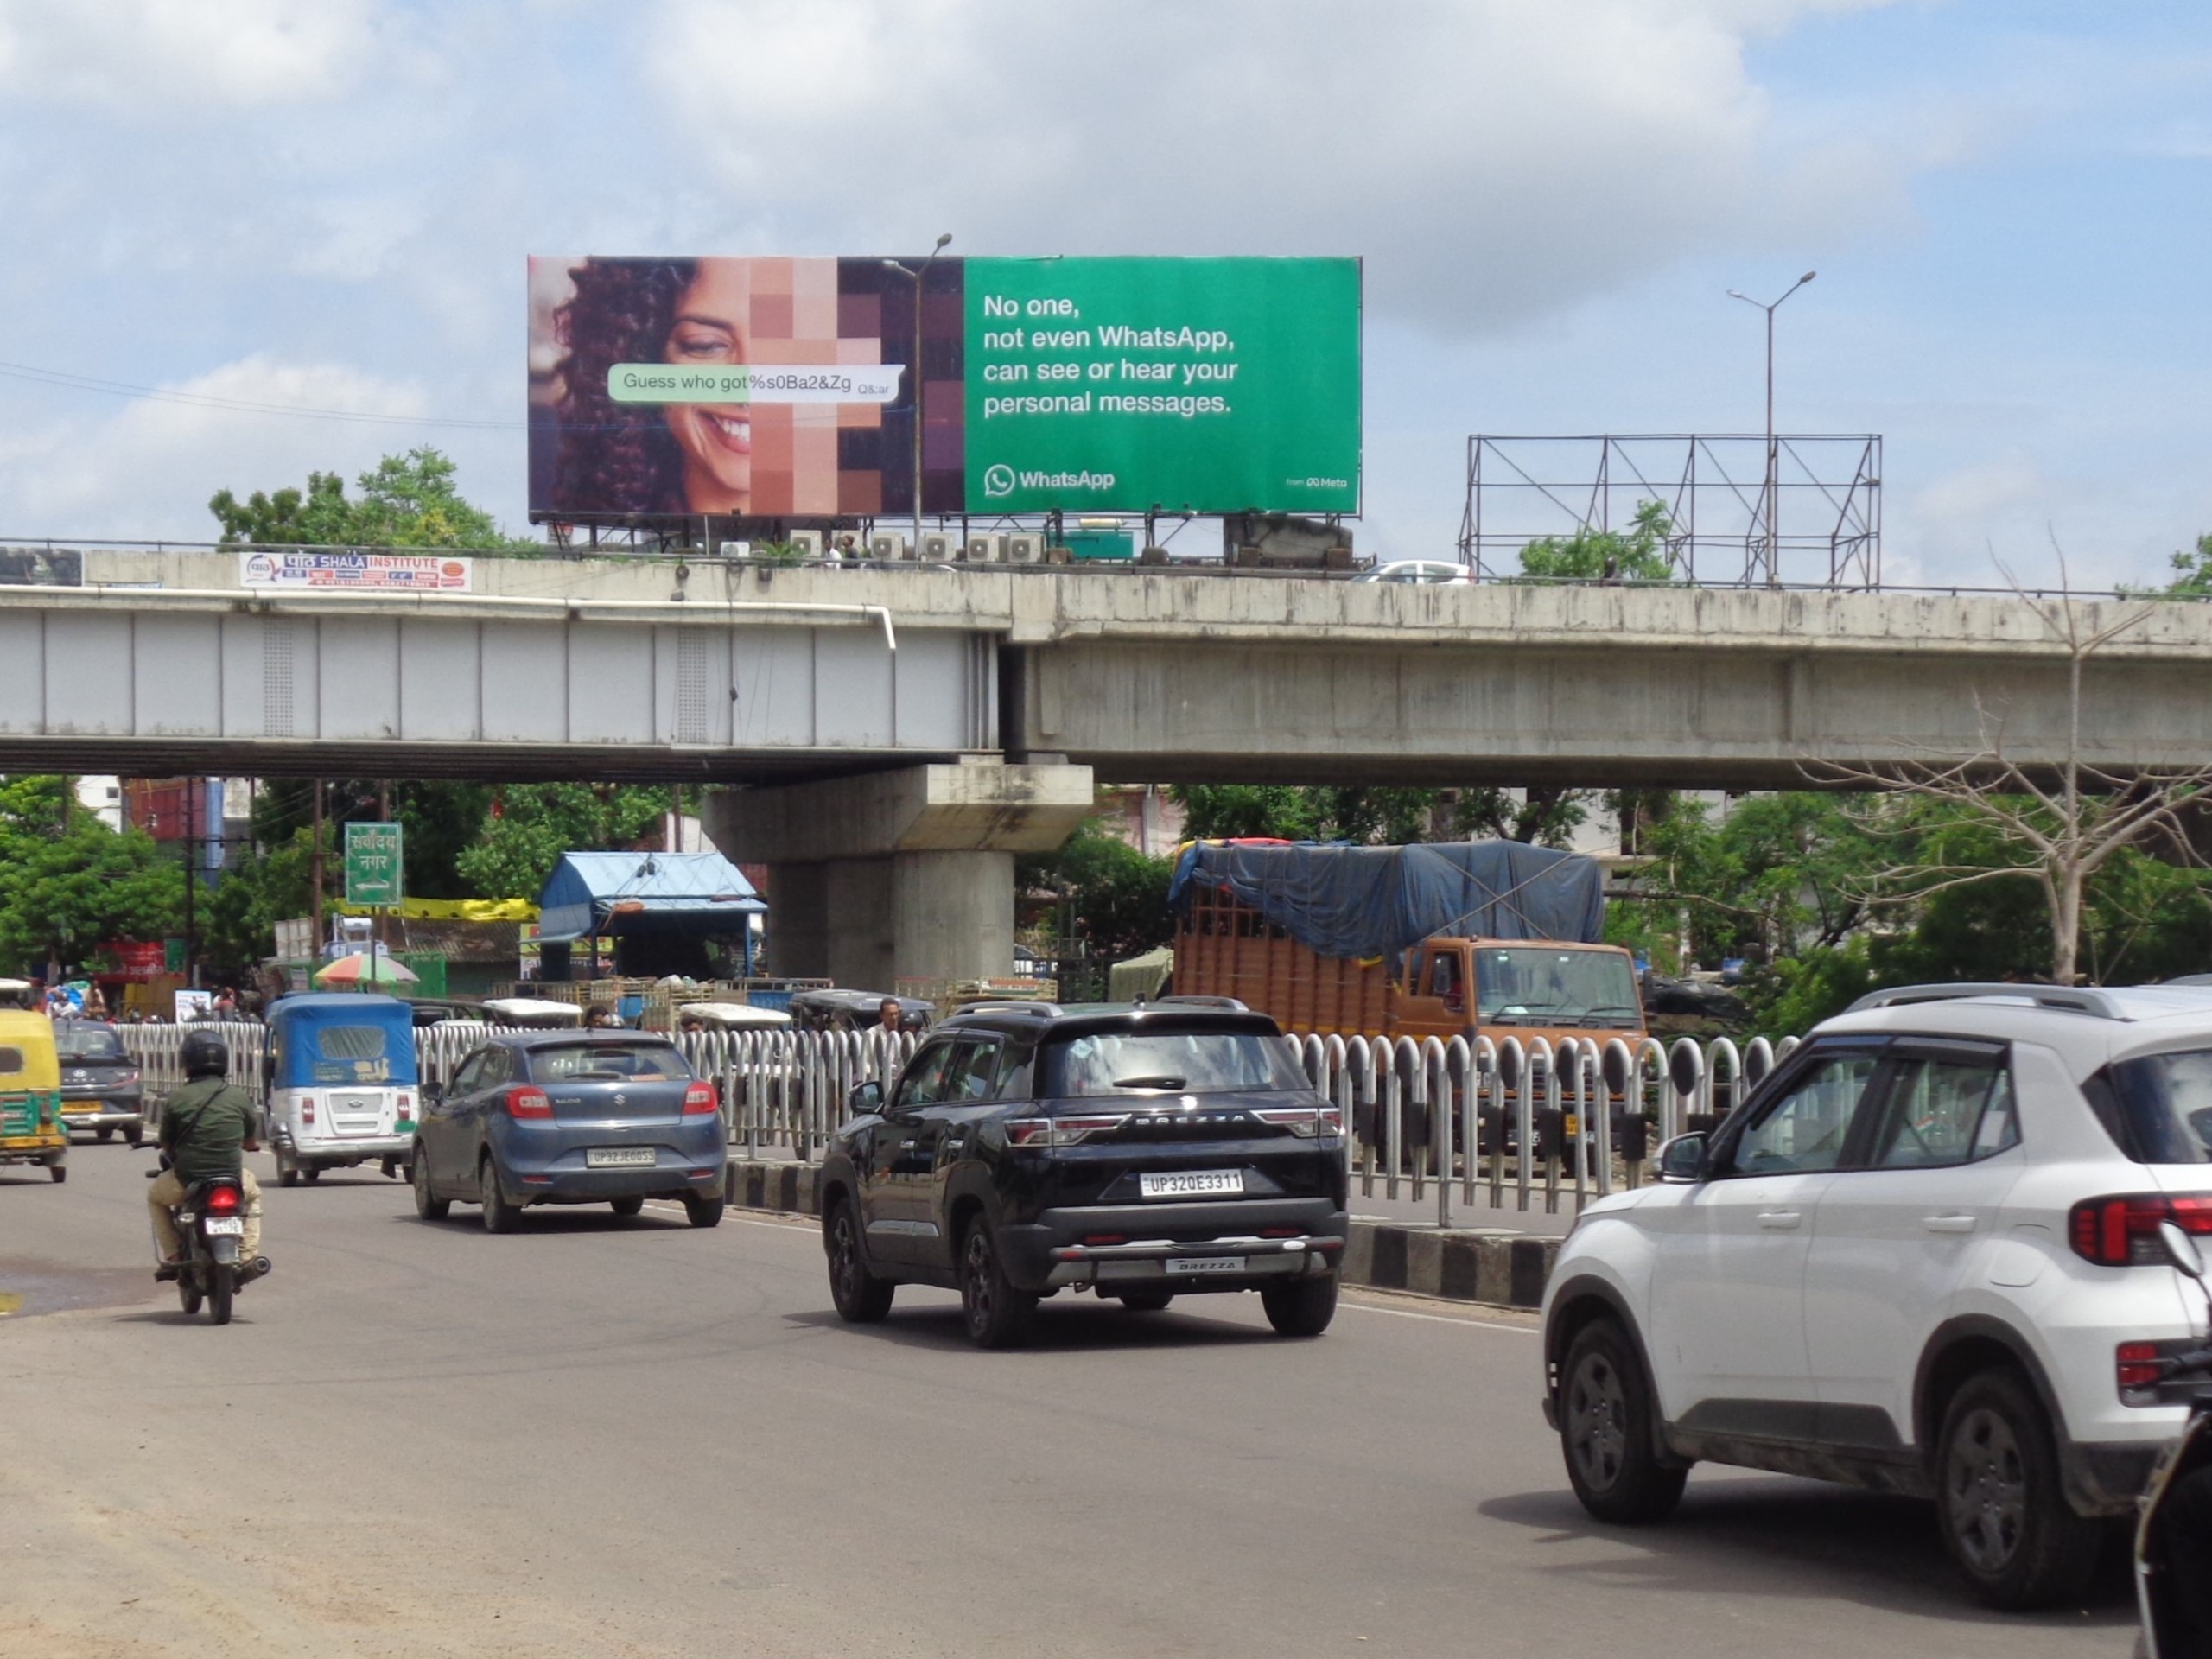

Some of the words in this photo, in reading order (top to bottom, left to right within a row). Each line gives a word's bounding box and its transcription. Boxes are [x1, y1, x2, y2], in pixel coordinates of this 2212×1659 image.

[984, 296, 1019, 316] No
[1027, 297, 1080, 319] one,
[984, 328, 1024, 348] not
[1031, 329, 1090, 347] even
[1098, 326, 1235, 353] WhatsApp,
[983, 362, 1028, 381] can
[1037, 361, 1080, 379] see
[1088, 361, 1114, 379] or
[1120, 357, 1176, 379] hear
[1183, 361, 1238, 385] your
[623, 372, 676, 388] Guess
[681, 374, 715, 389] who
[721, 375, 747, 393] got
[984, 391, 1090, 418] personal
[1098, 394, 1231, 417] messages.
[1019, 470, 1115, 490] WhatsApp
[1320, 478, 1347, 487] Meta
[286, 556, 315, 568] पाठ
[321, 556, 365, 568] SHALA
[370, 556, 439, 568] INSTITUTE
[359, 855, 387, 870] नगर
[1135, 1115, 1246, 1125] BREZZA
[1151, 1173, 1241, 1192] UP32QE3311
[1179, 1262, 1236, 1270] BREZZA
